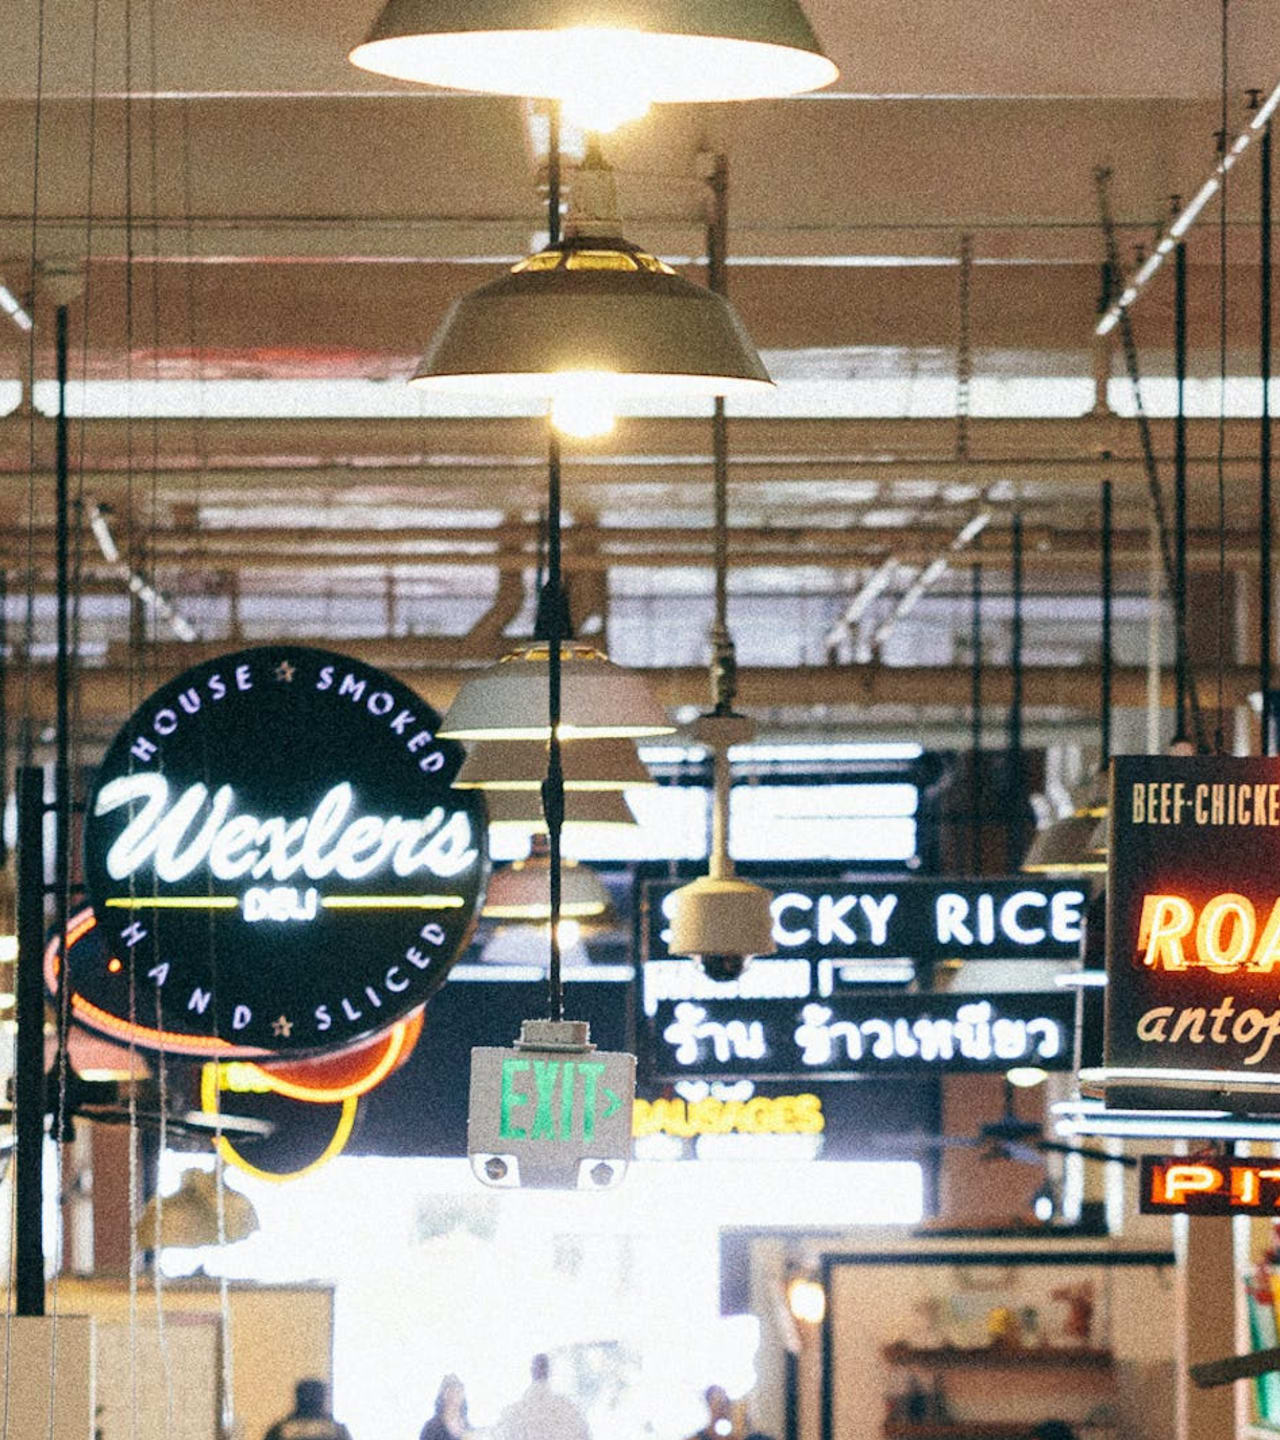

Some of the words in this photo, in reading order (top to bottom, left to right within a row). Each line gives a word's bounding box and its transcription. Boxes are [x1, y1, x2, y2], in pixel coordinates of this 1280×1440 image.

[131, 664, 253, 763] HOUSE
[316, 666, 446, 773] SMOKED
[95, 772, 478, 882] Wexler's
[935, 892, 1085, 945] RICE
[120, 921, 253, 1030] HAND
[315, 922, 446, 1032] SLICED
[497, 1058, 606, 1142] EXIT
